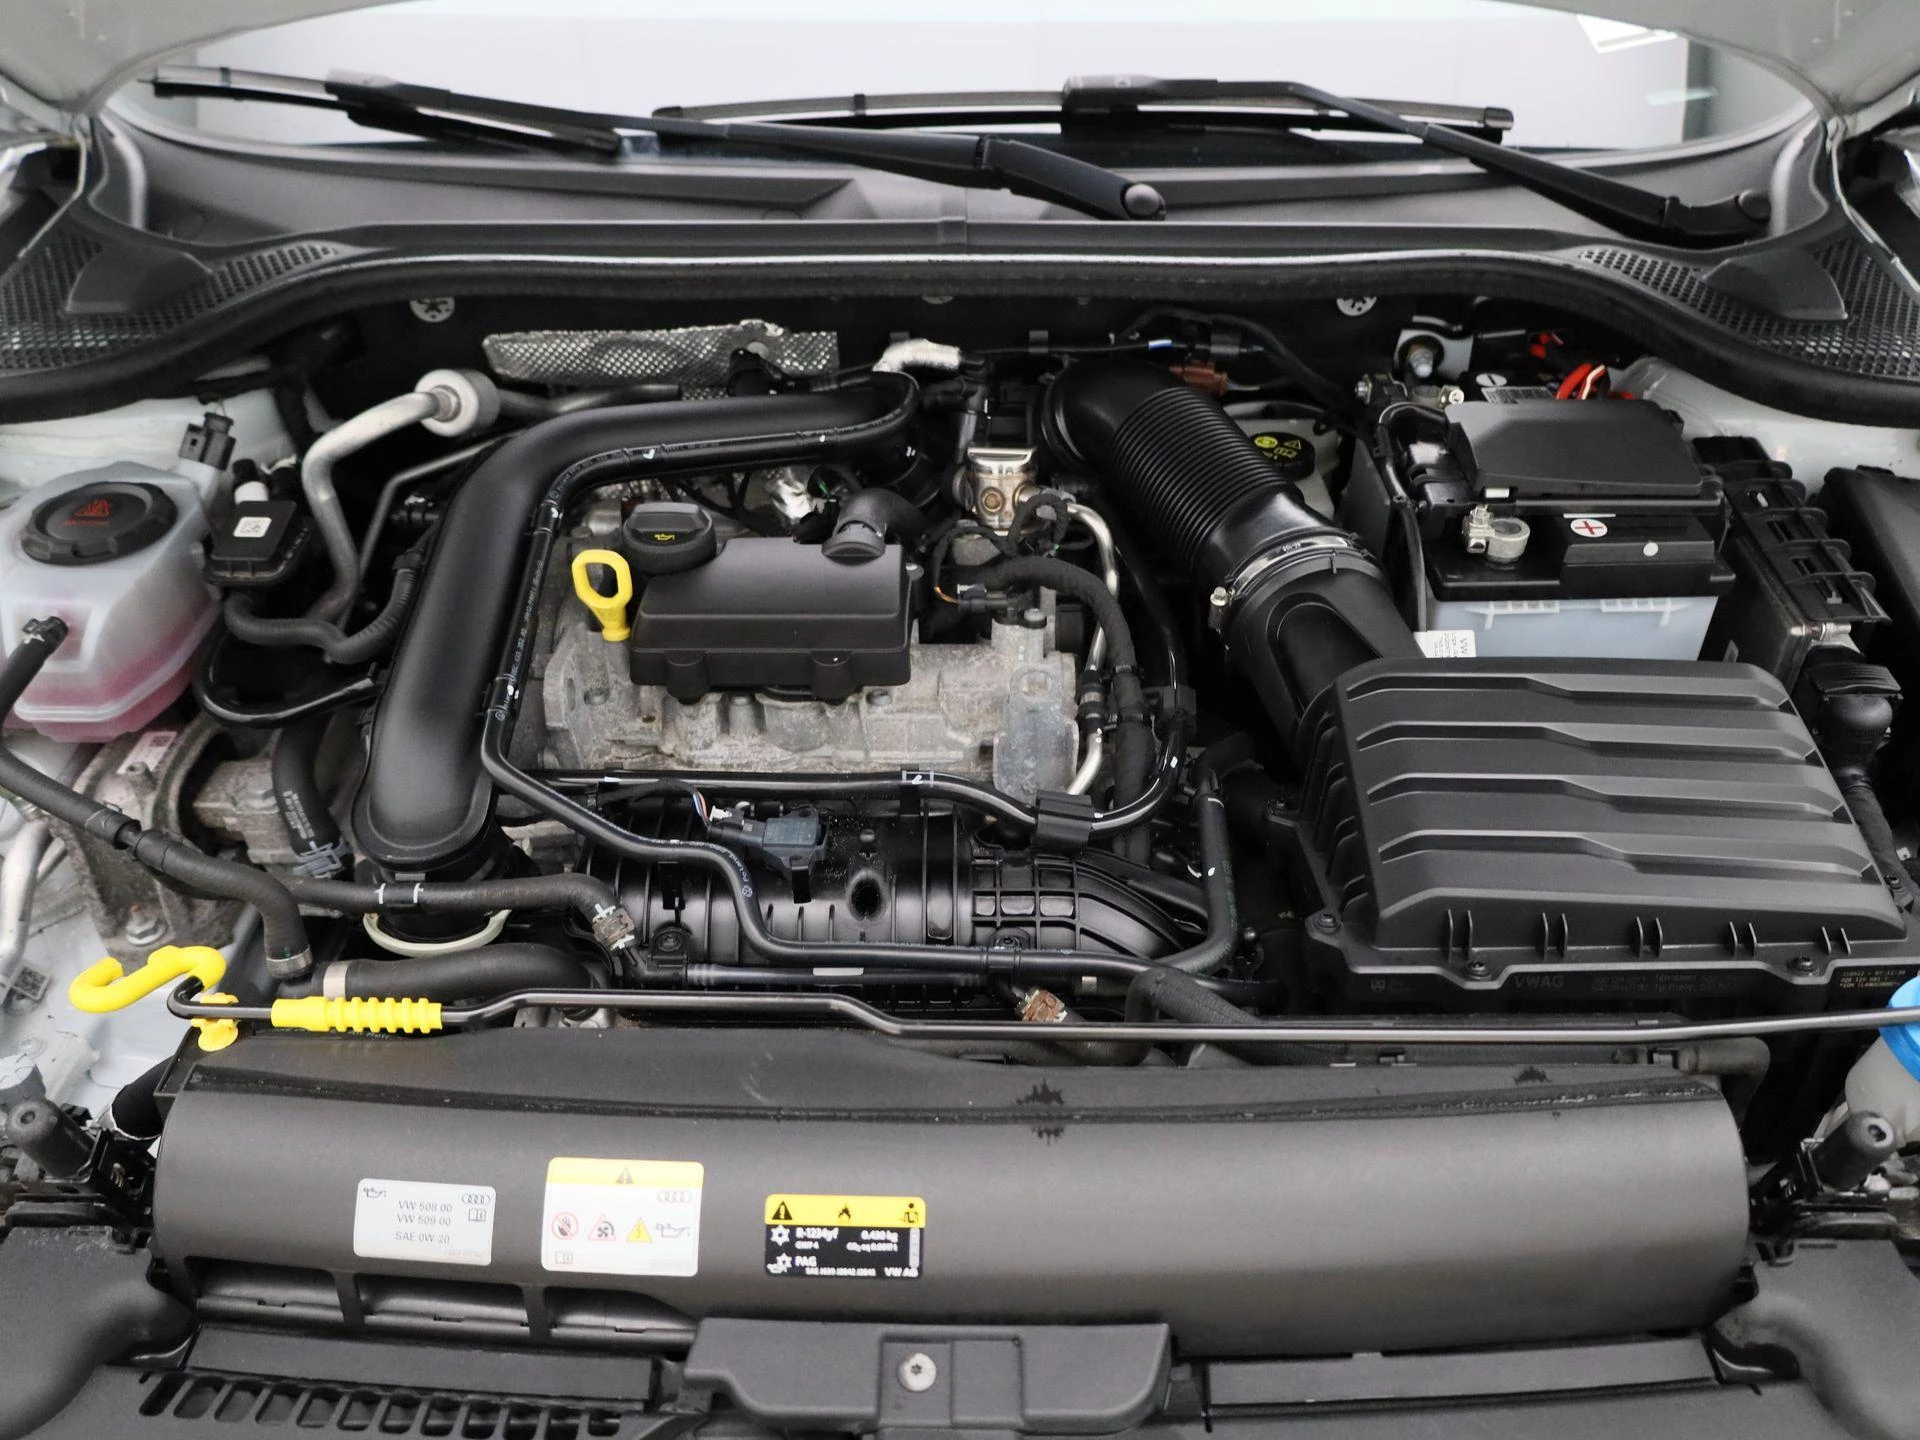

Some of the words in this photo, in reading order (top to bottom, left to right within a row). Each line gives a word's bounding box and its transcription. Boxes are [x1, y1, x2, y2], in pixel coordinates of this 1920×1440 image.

[399, 1200, 416, 1210] VW
[440, 1204, 452, 1213] 00
[397, 1214, 415, 1224] VW
[418, 1216, 436, 1226] 509
[439, 1217, 451, 1227] 00
[395, 1231, 416, 1242] SAE
[795, 1255, 817, 1267] PAG
[884, 1267, 902, 1277] VW
[902, 1267, 919, 1278] AG
